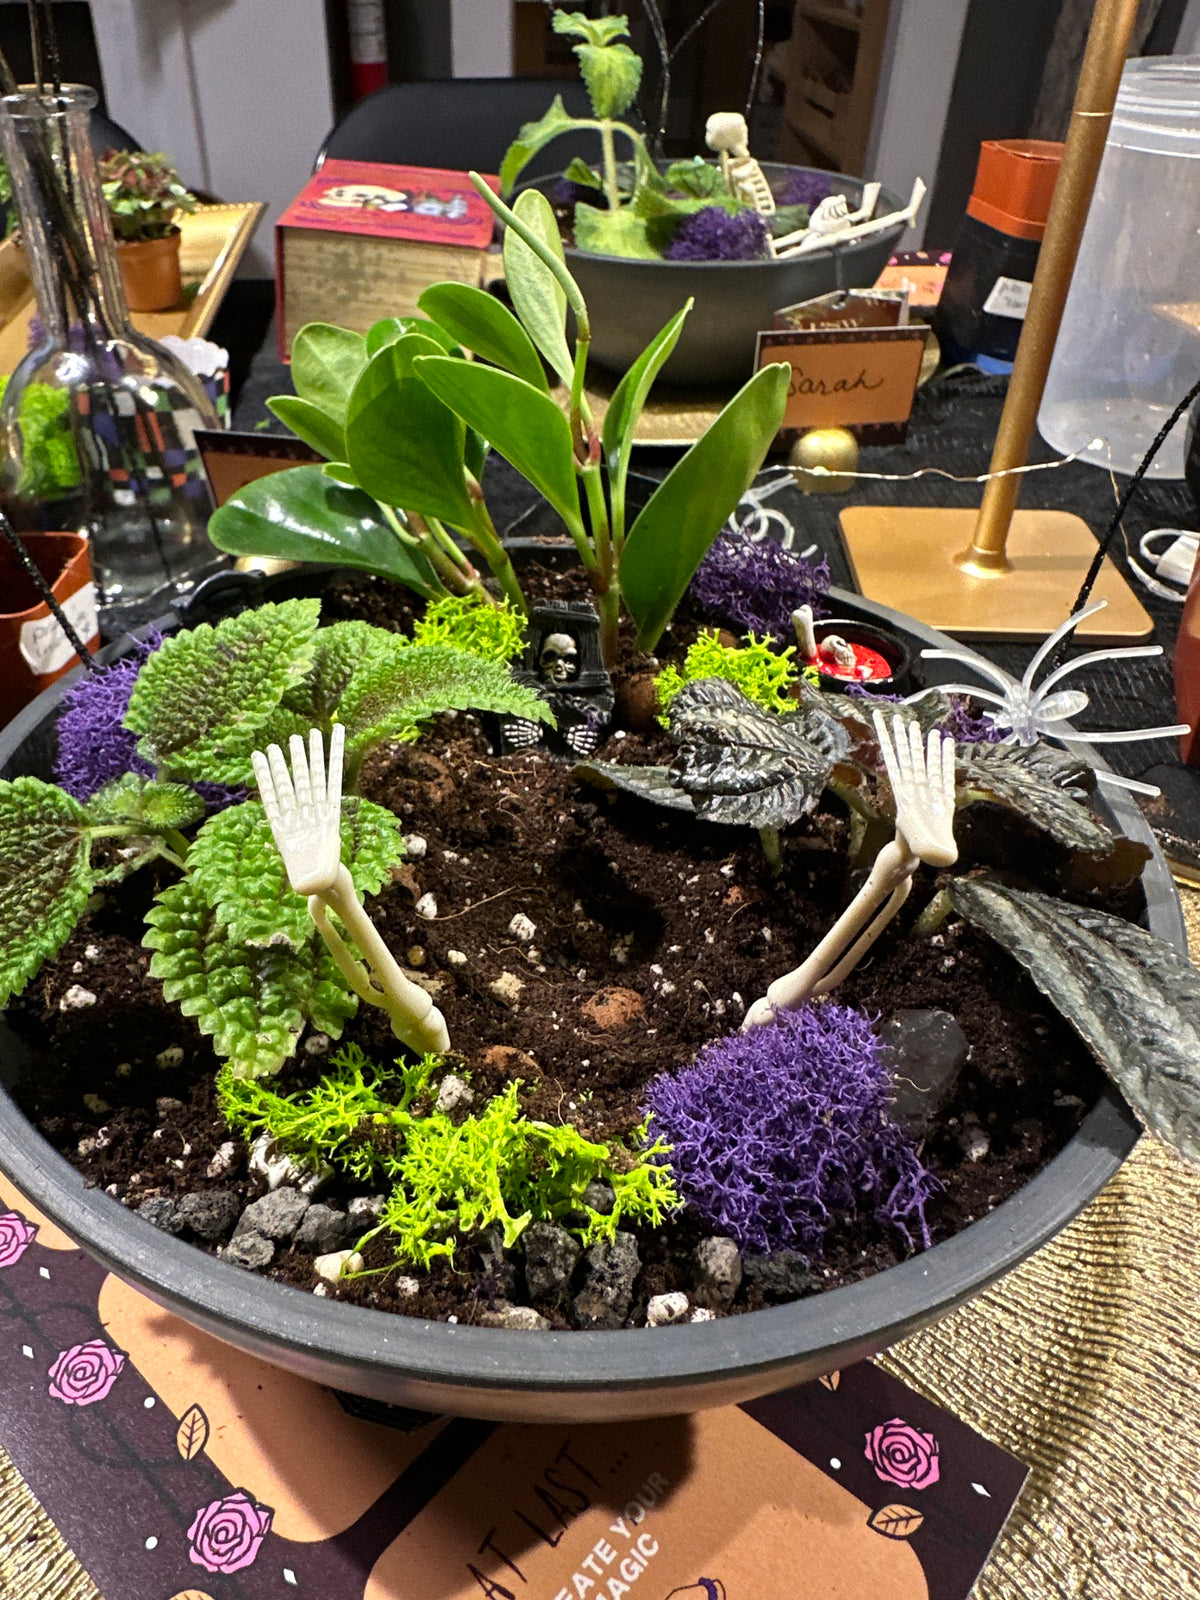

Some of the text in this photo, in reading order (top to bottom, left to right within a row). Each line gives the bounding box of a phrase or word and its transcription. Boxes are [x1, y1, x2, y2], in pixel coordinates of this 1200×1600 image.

[787, 367, 884, 397] Sarah
[609, 1471, 670, 1540] YOUR
[467, 1527, 527, 1600] AT
[595, 1533, 659, 1600] AGIC
